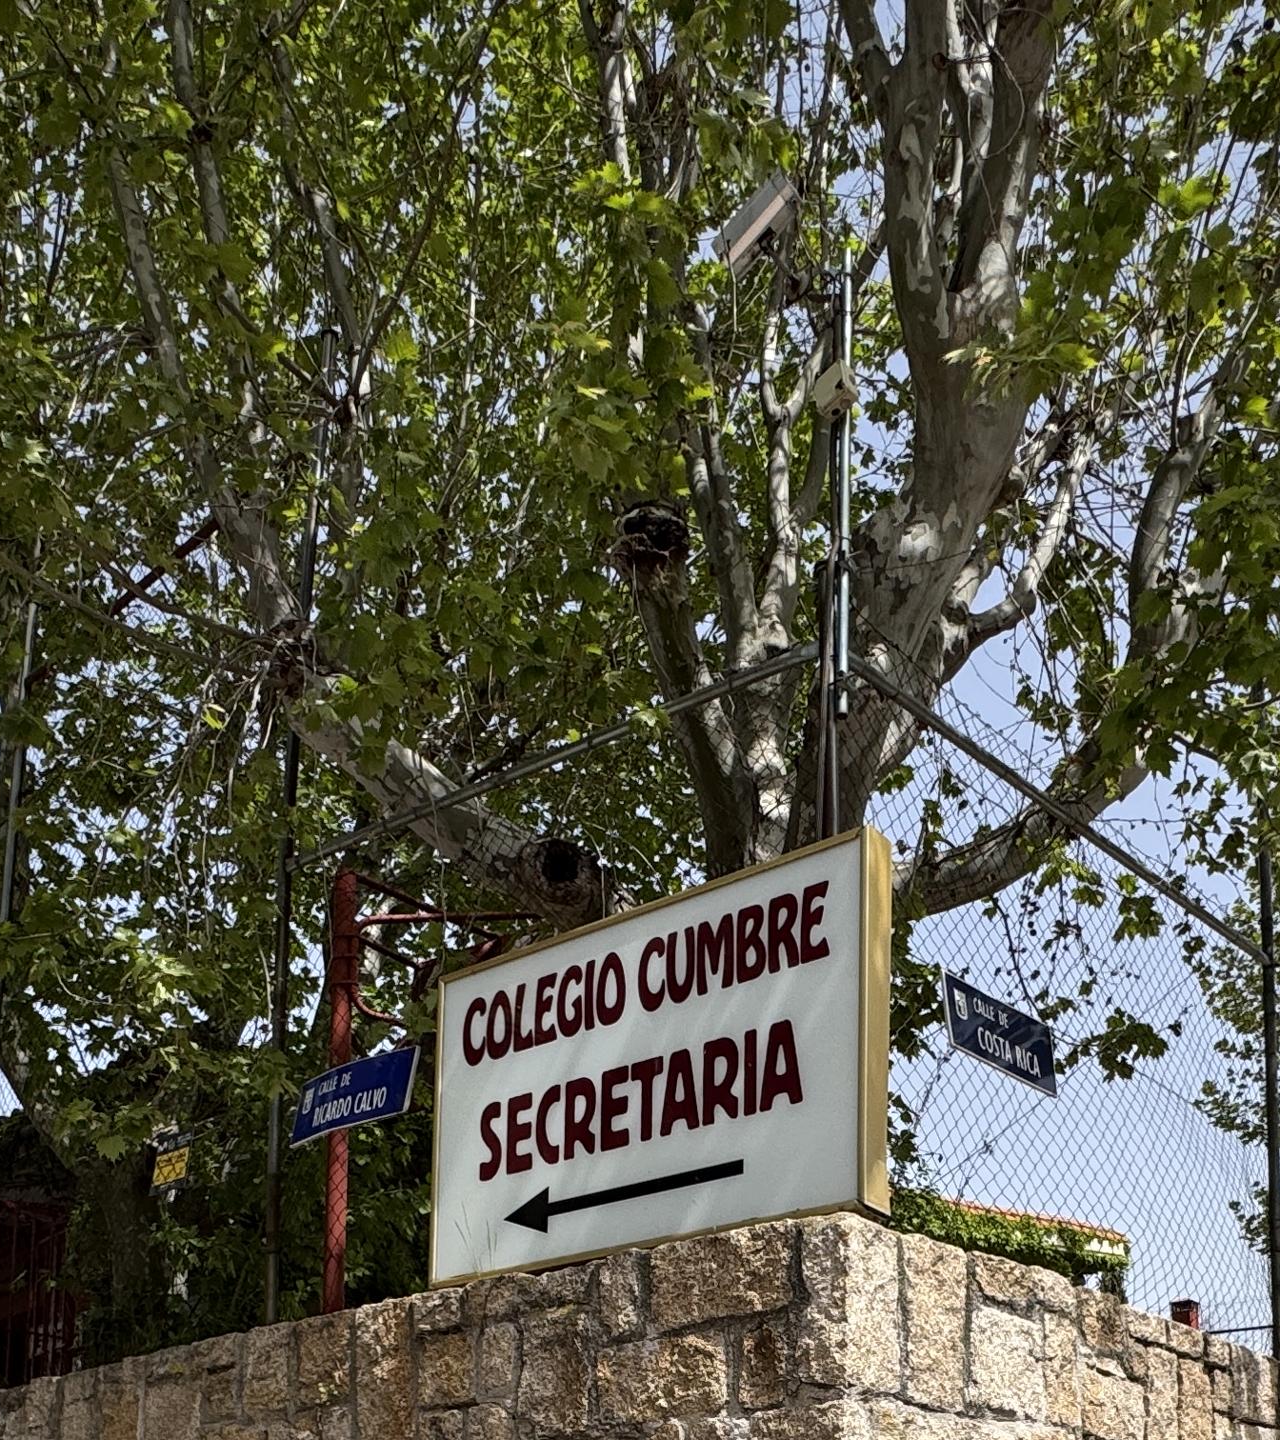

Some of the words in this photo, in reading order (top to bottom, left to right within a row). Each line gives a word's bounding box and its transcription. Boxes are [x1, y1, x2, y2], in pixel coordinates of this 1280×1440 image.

[463, 952, 627, 1067] COLEGIO
[638, 880, 830, 1012] CUMBRE
[973, 997, 995, 1021] CALLE
[998, 1010, 1010, 1029] DE
[977, 1026, 1013, 1065] COSTA
[1015, 1045, 1042, 1079] RICA
[312, 1095, 352, 1128] RICARDO
[354, 1086, 387, 1114] CALVO
[319, 1076, 338, 1096] CALLE
[340, 1071, 352, 1086] DE
[478, 1019, 804, 1182] SECRETARIA
